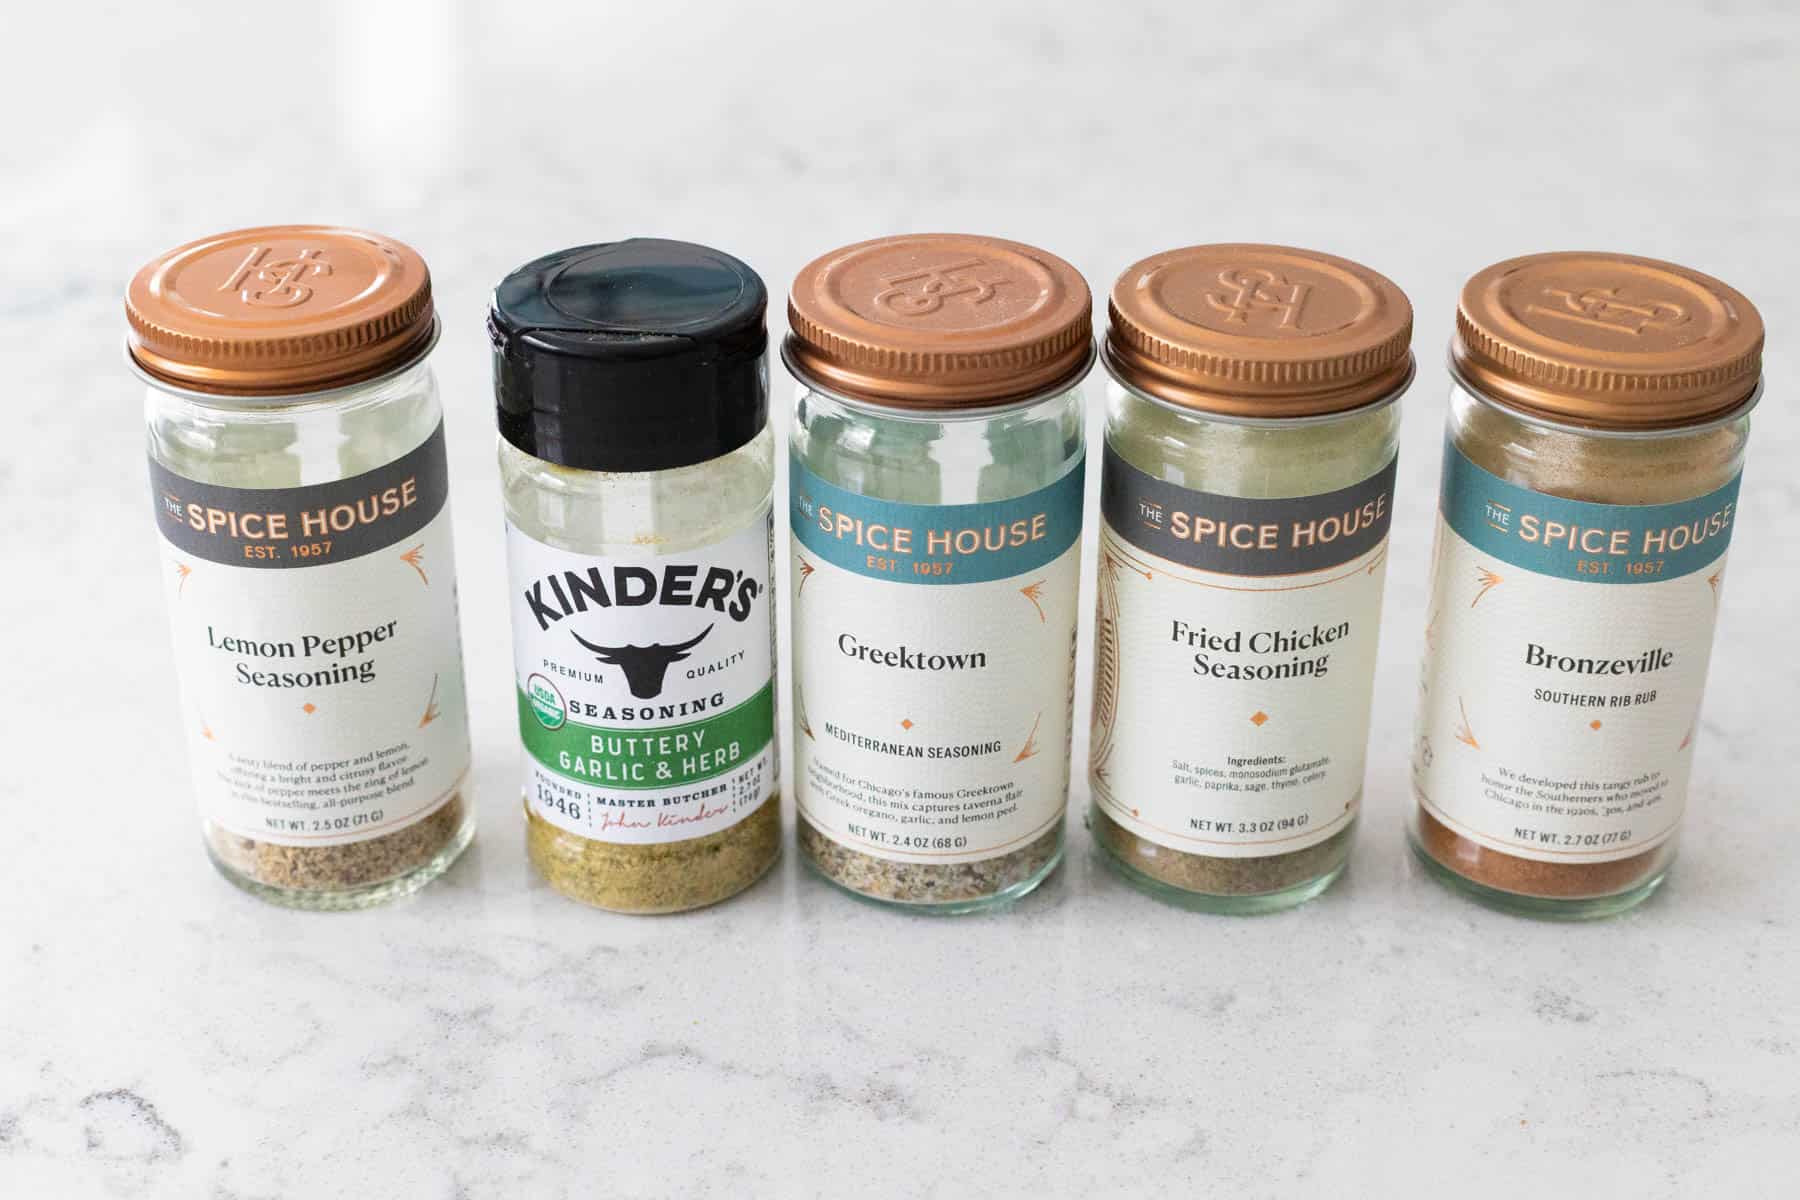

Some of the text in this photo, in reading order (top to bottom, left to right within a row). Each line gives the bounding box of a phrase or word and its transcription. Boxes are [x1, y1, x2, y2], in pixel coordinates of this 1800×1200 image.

[164, 476, 417, 540] THE SPICE HOUSE
[818, 506, 912, 553] SPICE
[927, 513, 1047, 555] HOUSE
[1139, 493, 1387, 550] THE SPICE HOUSE
[1484, 502, 1731, 555] THE SPICE HOUSE
[245, 541, 332, 560] EST. 1957
[912, 562, 953, 576] 1957
[1576, 560, 1665, 575] EST. 1957
[524, 565, 759, 631] KINDER'S
[208, 620, 398, 658] Lemon Pepper
[1171, 620, 1350, 655] Fried Chicken
[838, 634, 987, 671] Greektown
[1525, 643, 1673, 676] Bronzeville
[236, 659, 376, 688] Seasoning
[543, 649, 745, 684] PREMIUM QUALITY
[1193, 653, 1330, 681] Seasoning
[533, 683, 556, 705] USDA
[569, 691, 725, 721] SEASONING
[1534, 688, 1656, 708] SOUTHERN RIB RUB
[591, 730, 705, 757] BUTTERY
[825, 722, 1001, 760] MEDITERRANEAN SEASONING
[296, 762, 307, 772] of
[311, 760, 350, 774] pepper
[353, 752, 373, 766] and
[560, 741, 740, 782] GARLIC & HERB
[1227, 755, 1287, 768] Ingredients:
[1229, 766, 1288, 779] monosodium
[308, 785, 341, 797] meets
[344, 779, 361, 793] the
[388, 770, 399, 783] of
[316, 773, 336, 784] and
[535, 770, 582, 800] FOUNDED
[858, 777, 909, 799] Chicago's
[912, 788, 954, 801] famous
[957, 780, 1015, 798] Greektown
[1518, 773, 1576, 791] developed
[1579, 780, 1600, 791] this
[536, 783, 581, 820] 1946
[597, 796, 656, 808] MASTER
[663, 783, 728, 806] BUTCHER
[868, 794, 888, 809] this
[890, 799, 910, 810] mix
[911, 800, 960, 814] captures
[963, 796, 1003, 811] taverna
[1484, 790, 1530, 810] Chicago
[1532, 801, 1543, 811] in
[1545, 804, 1564, 815] the
[1515, 785, 1533, 797] the
[1606, 791, 1628, 802] who
[266, 817, 285, 829] NET
[312, 817, 331, 831] 2.5
[334, 815, 350, 829] OZ
[353, 813, 369, 826] (71
[370, 810, 384, 823] G)
[937, 814, 959, 825] and
[961, 811, 994, 824] lemon
[1190, 813, 1309, 834] NET WT. 3.3 OZ (94 G)
[848, 823, 967, 849] NET WT. 2.4 OZ (68 G)
[1514, 827, 1535, 841] NET
[1540, 831, 1561, 845] WT.
[1564, 832, 1582, 846] 2.7
[1584, 832, 1599, 846] OZ
[1602, 832, 1619, 844] (77
